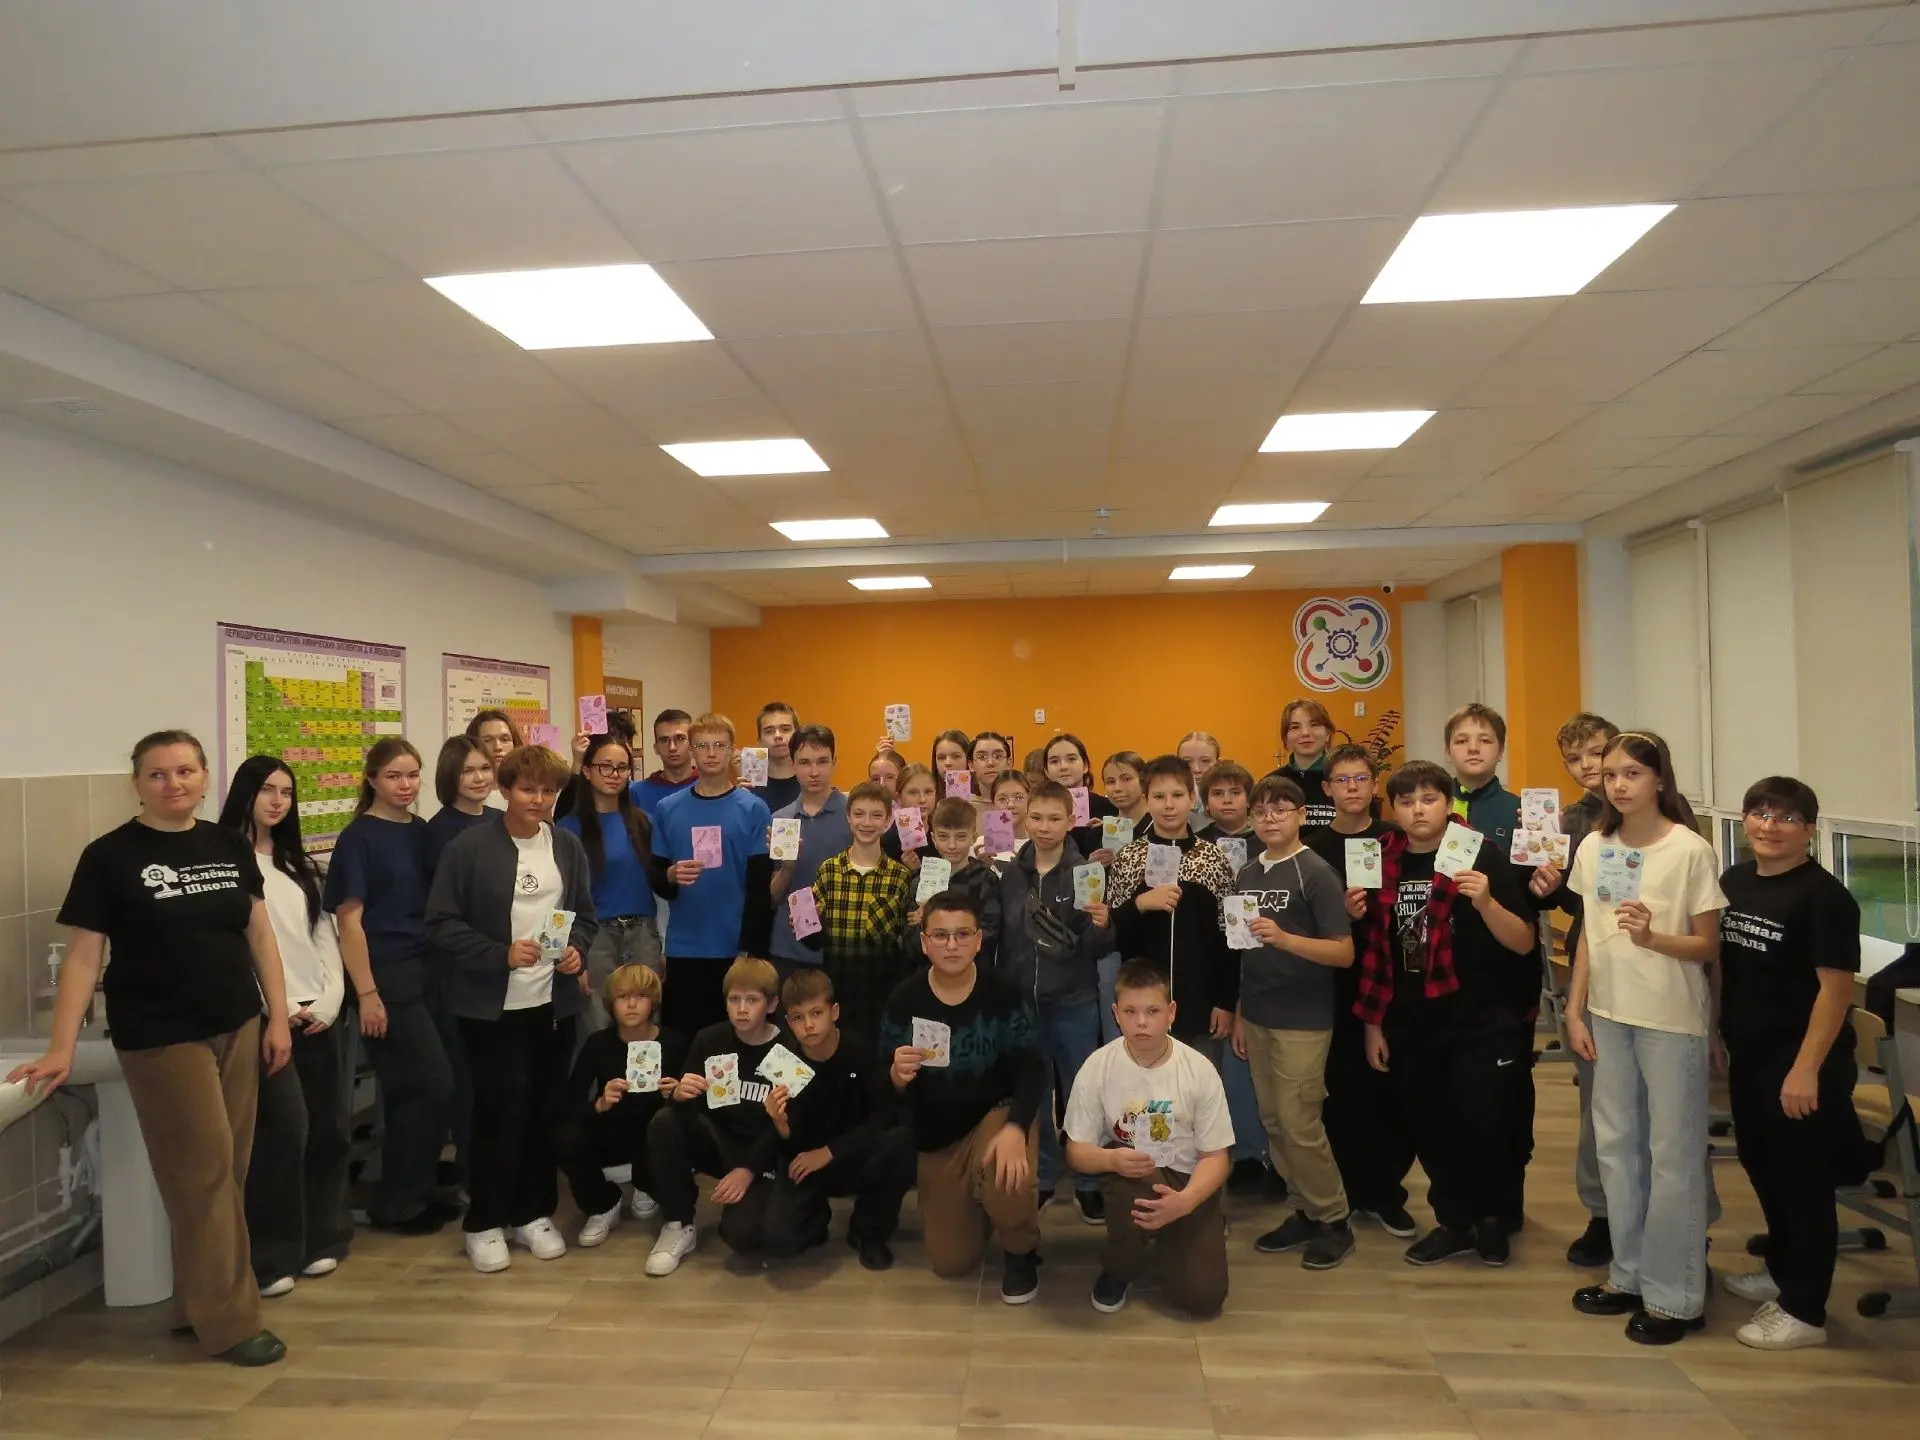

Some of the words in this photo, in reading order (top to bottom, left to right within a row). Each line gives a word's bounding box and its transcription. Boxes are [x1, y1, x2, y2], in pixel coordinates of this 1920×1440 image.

[1305, 808, 1336, 817] лёна
[180, 869, 240, 883] Зелёная
[184, 881, 238, 894] Школа
[1723, 916, 1783, 941] Зелёная
[1725, 931, 1767, 952] Шола
[741, 1080, 772, 1103] MA
